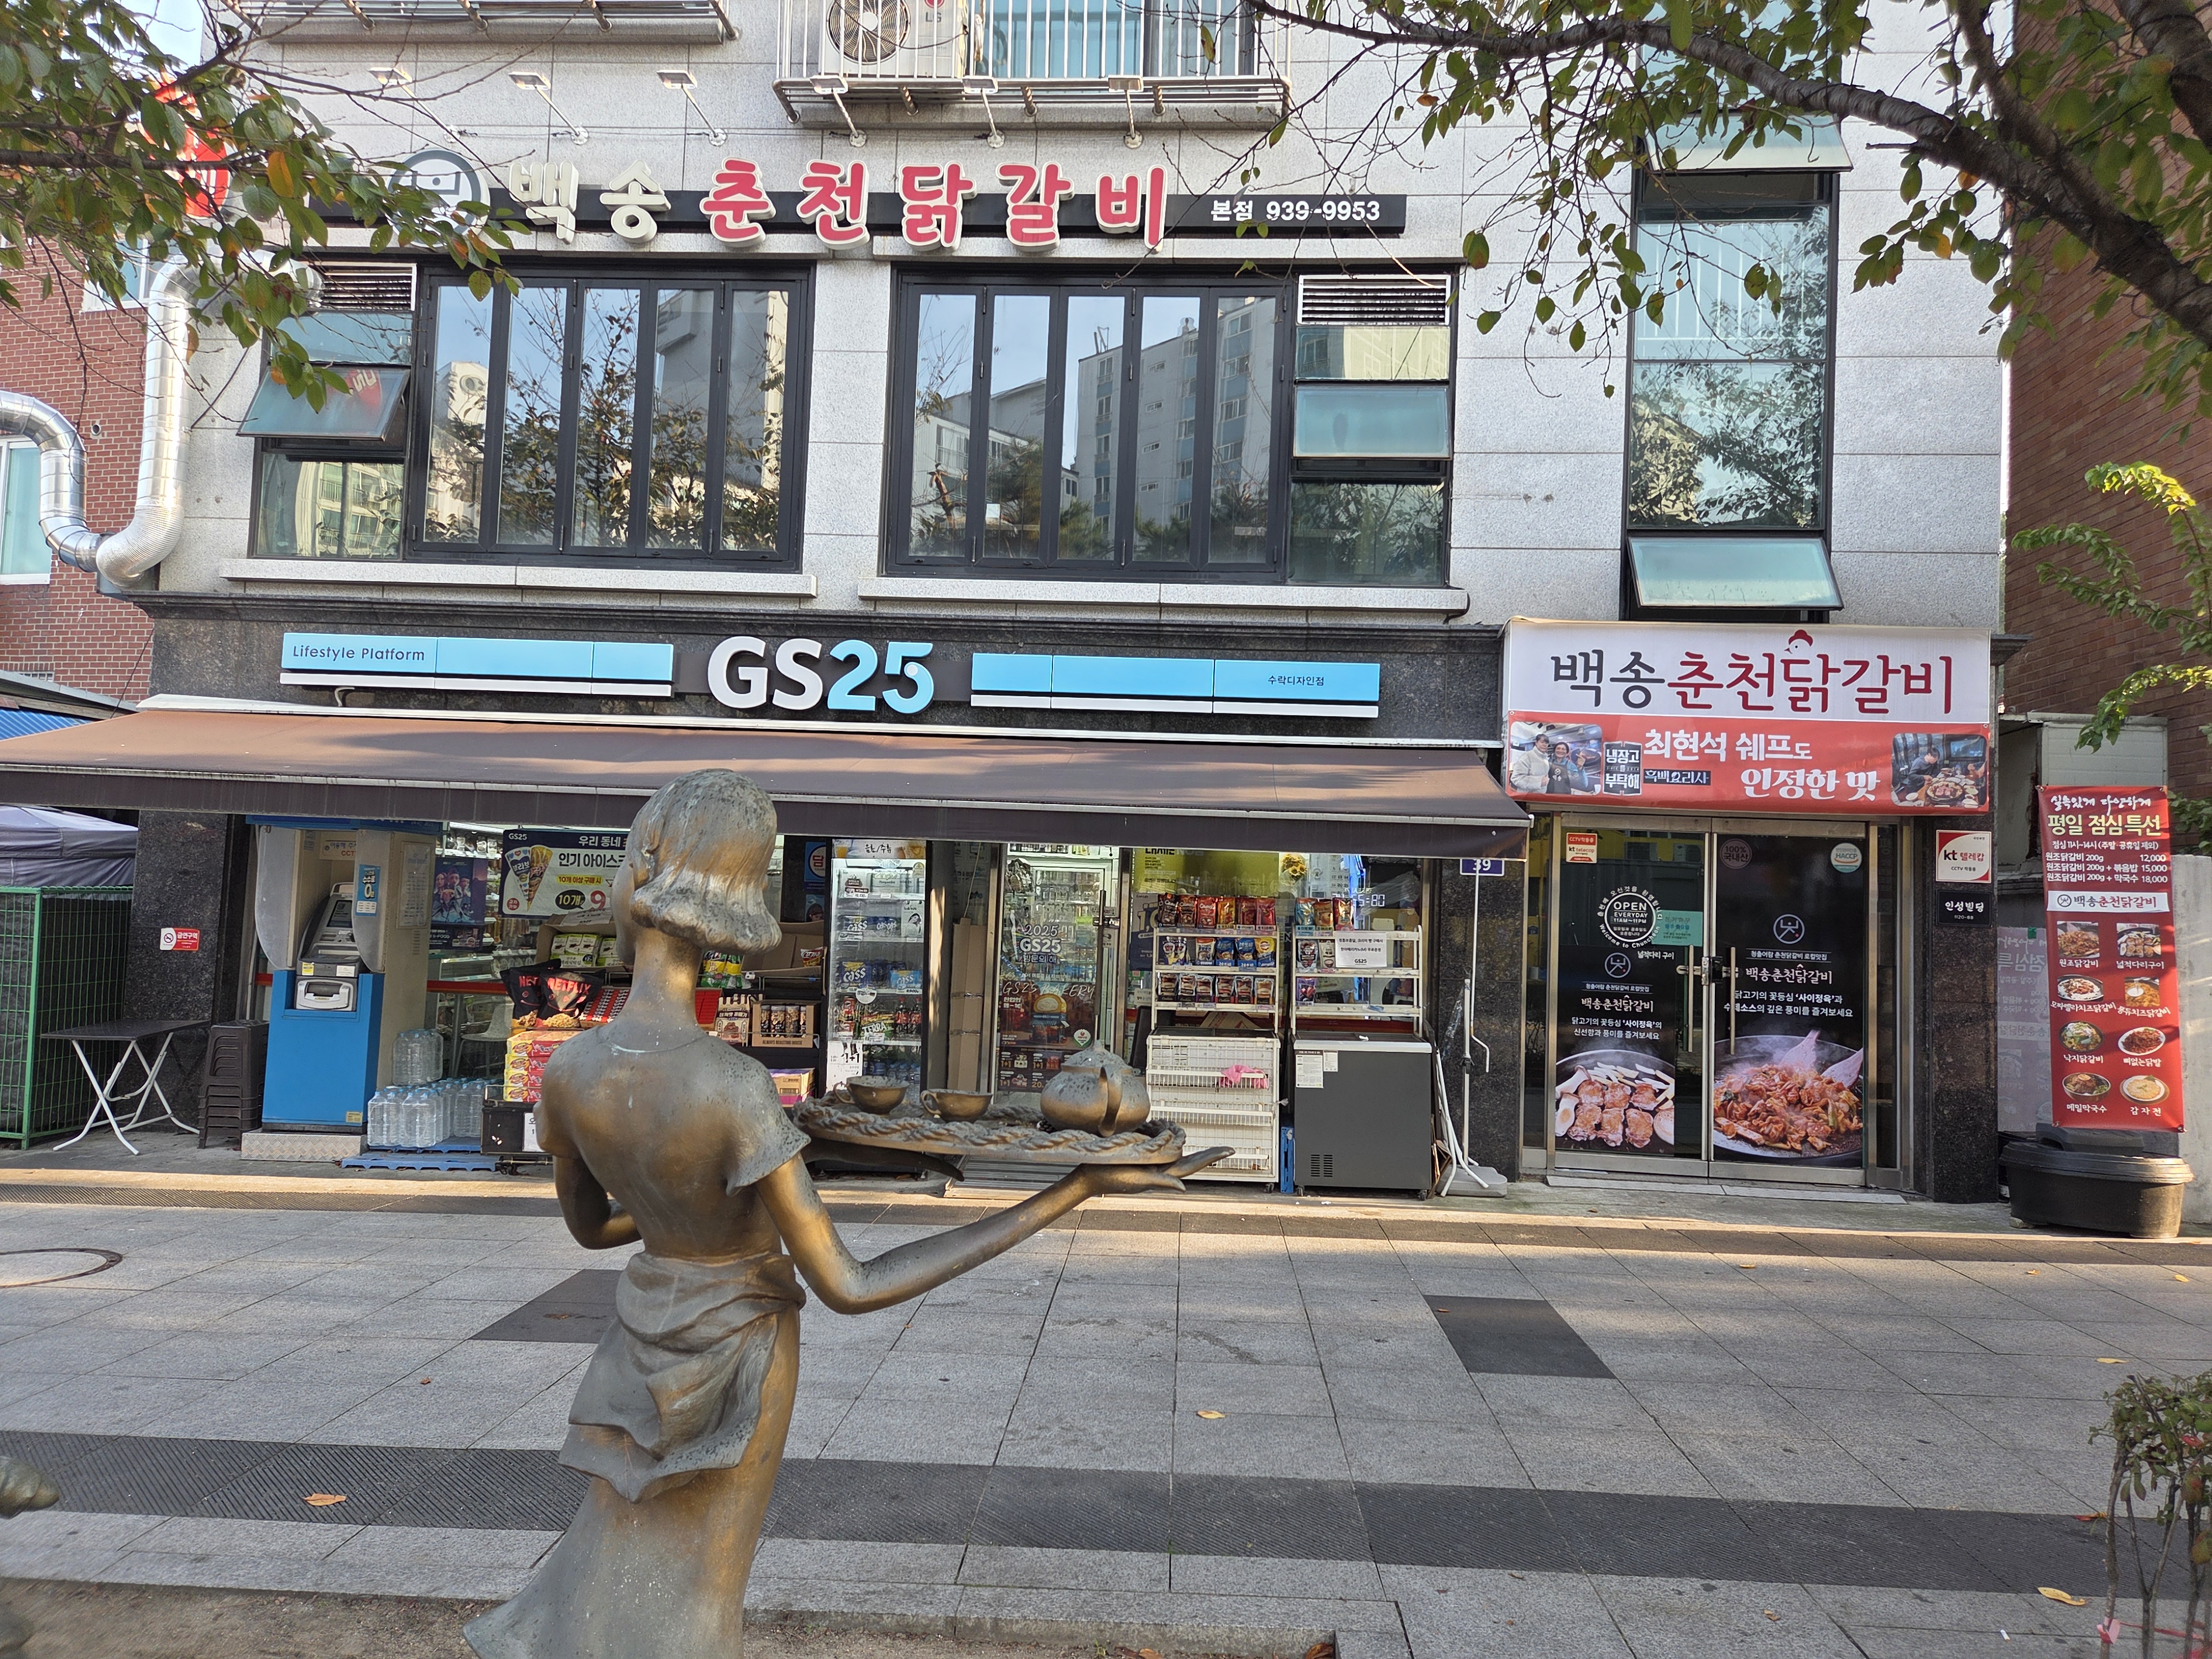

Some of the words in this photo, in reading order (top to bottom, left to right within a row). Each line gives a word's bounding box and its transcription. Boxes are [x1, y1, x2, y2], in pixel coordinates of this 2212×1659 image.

[1211, 199, 1253, 222] 본점
[1266, 199, 1381, 221] 939-9953
[293, 645, 356, 661] Lifestyle
[362, 648, 425, 661] Platform
[708, 636, 935, 714] GS25
[1267, 674, 1325, 687] 수락디자인점
[1644, 729, 1727, 762] 최현석
[1735, 732, 1812, 761] 쉐프도
[1606, 749, 1640, 764] 냉장고
[1605, 774, 1640, 789] 부탁해
[1645, 770, 1709, 784] 흑백요리사
[1742, 768, 1840, 800] 인정한
[1847, 770, 1881, 802] 맛
[2051, 795, 2095, 811] 실속있게
[2048, 814, 2083, 836] 평일
[578, 836, 598, 847] 우리
[601, 836, 621, 847] 동네
[2052, 841, 2066, 849] 점심
[559, 853, 581, 868] 인기
[1944, 849, 1958, 861] kt
[1960, 852, 1985, 862] 텔레캅
[2085, 854, 2104, 862] 200g
[2140, 854, 2167, 863] 12,000
[2086, 864, 2105, 872] 200g
[2141, 864, 2168, 873] 15,000
[2086, 874, 2105, 882] 200g
[2141, 875, 2168, 884] 18,000
[1613, 901, 1647, 911] OPEN
[1945, 901, 1984, 913] 인성빌딩
[1599, 924, 1620, 946] Welcome
[1020, 937, 1062, 953] GS25
[2059, 959, 2099, 968] 원조닭갈비
[547, 977, 592, 995] NETFLIX
[1003, 980, 1037, 994] GS25
[862, 1022, 886, 1034] TERRA
[2063, 1054, 2104, 1063] 낙지닭갈비
[2067, 1104, 2107, 1113] 메밀막국수
